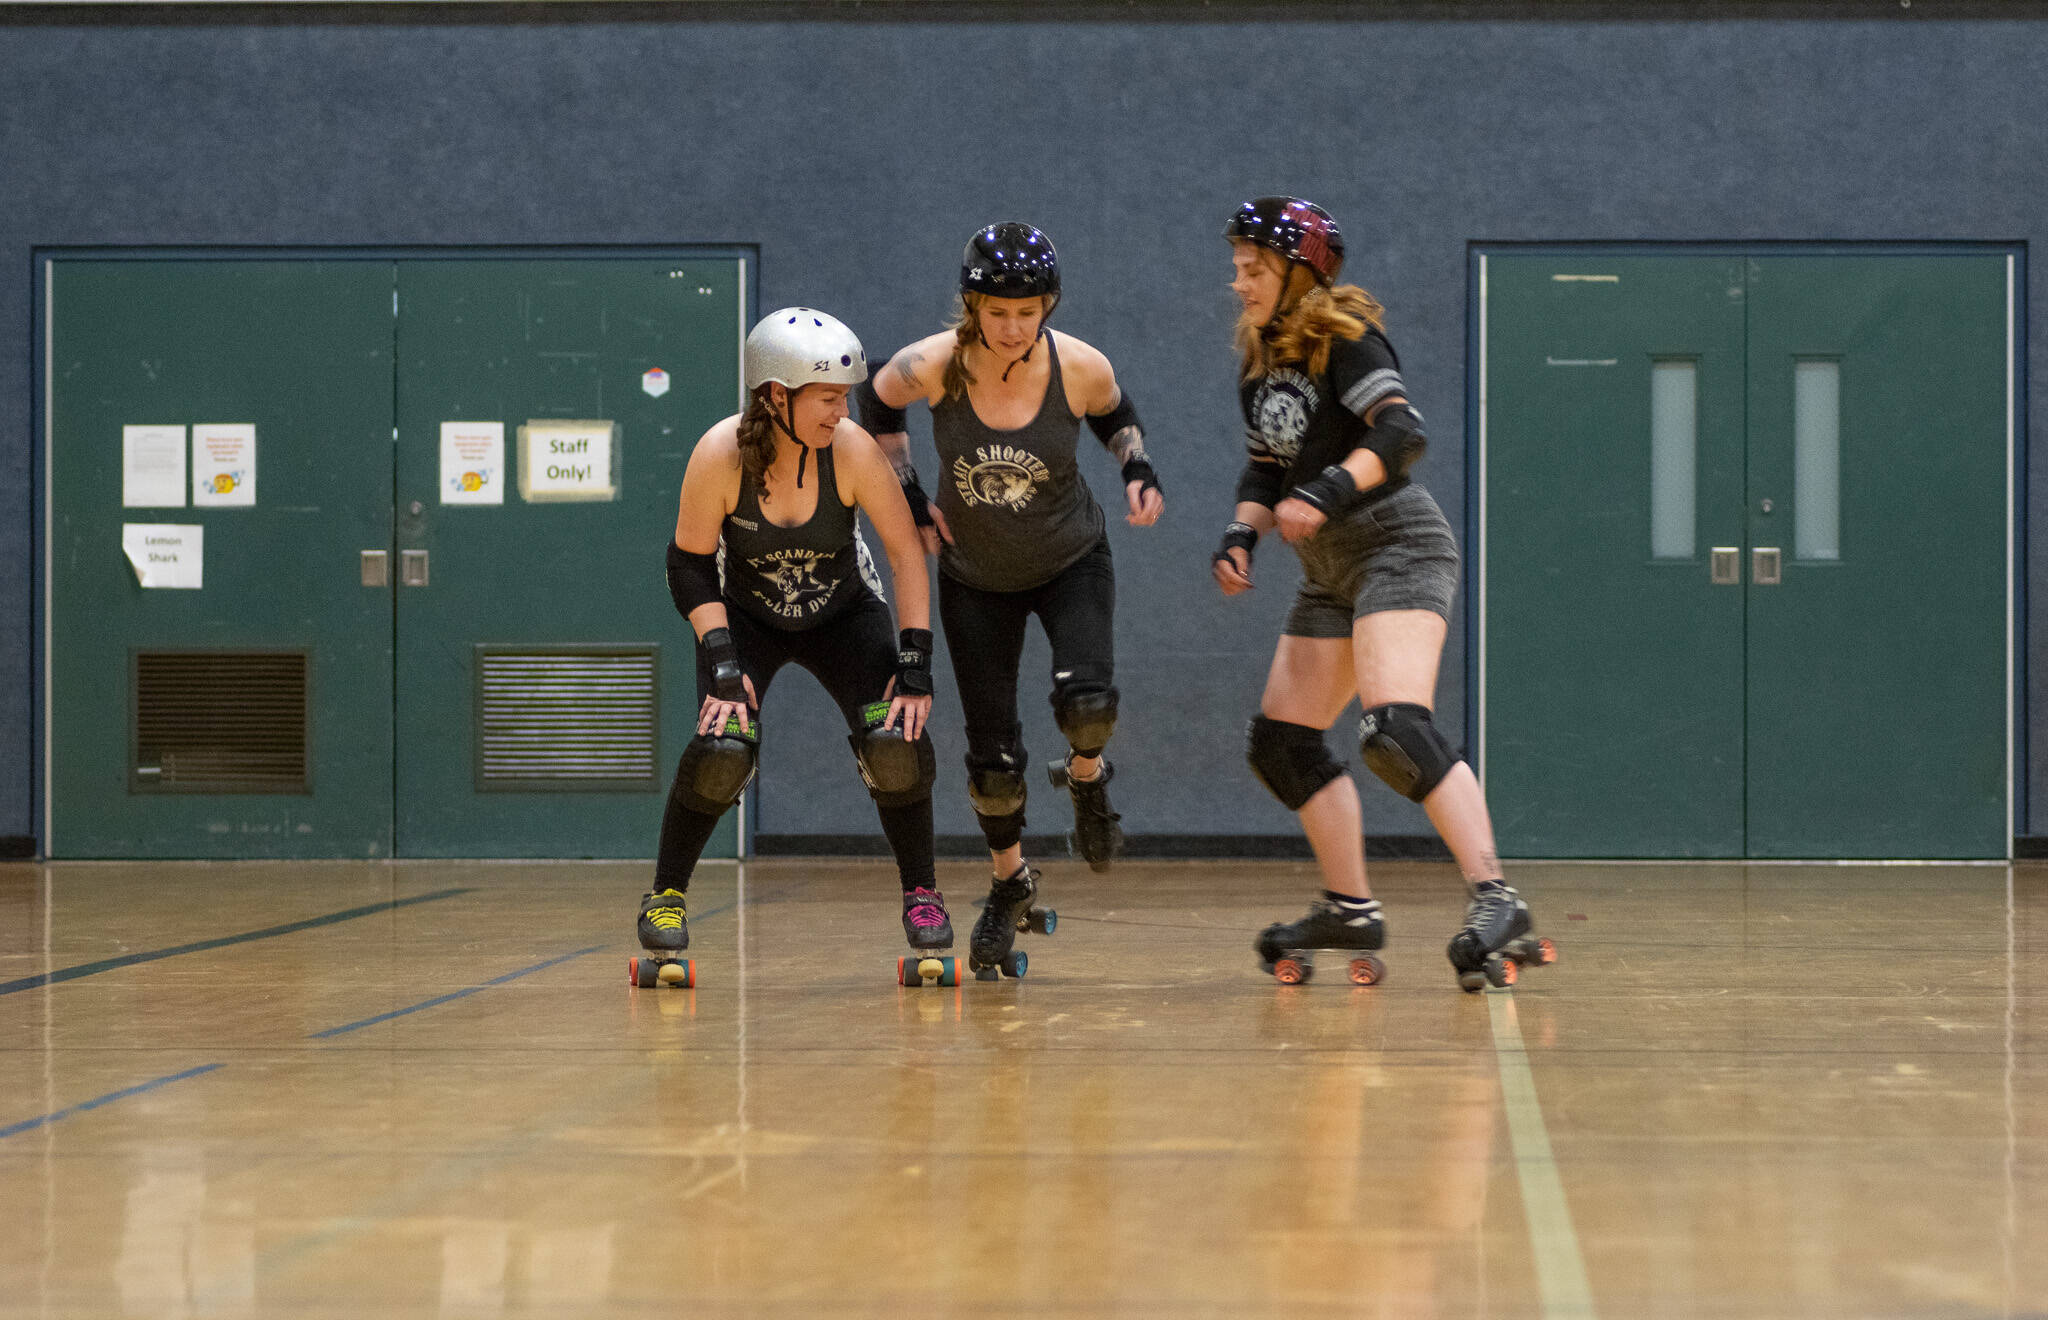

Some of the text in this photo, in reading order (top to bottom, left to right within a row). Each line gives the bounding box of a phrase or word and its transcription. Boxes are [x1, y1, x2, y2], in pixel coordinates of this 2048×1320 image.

[812, 360, 831, 373] S1
[549, 439, 589, 454] Staff
[546, 464, 592, 482] Only!
[145, 535, 182, 546] Lemon
[148, 552, 179, 563] Shark
